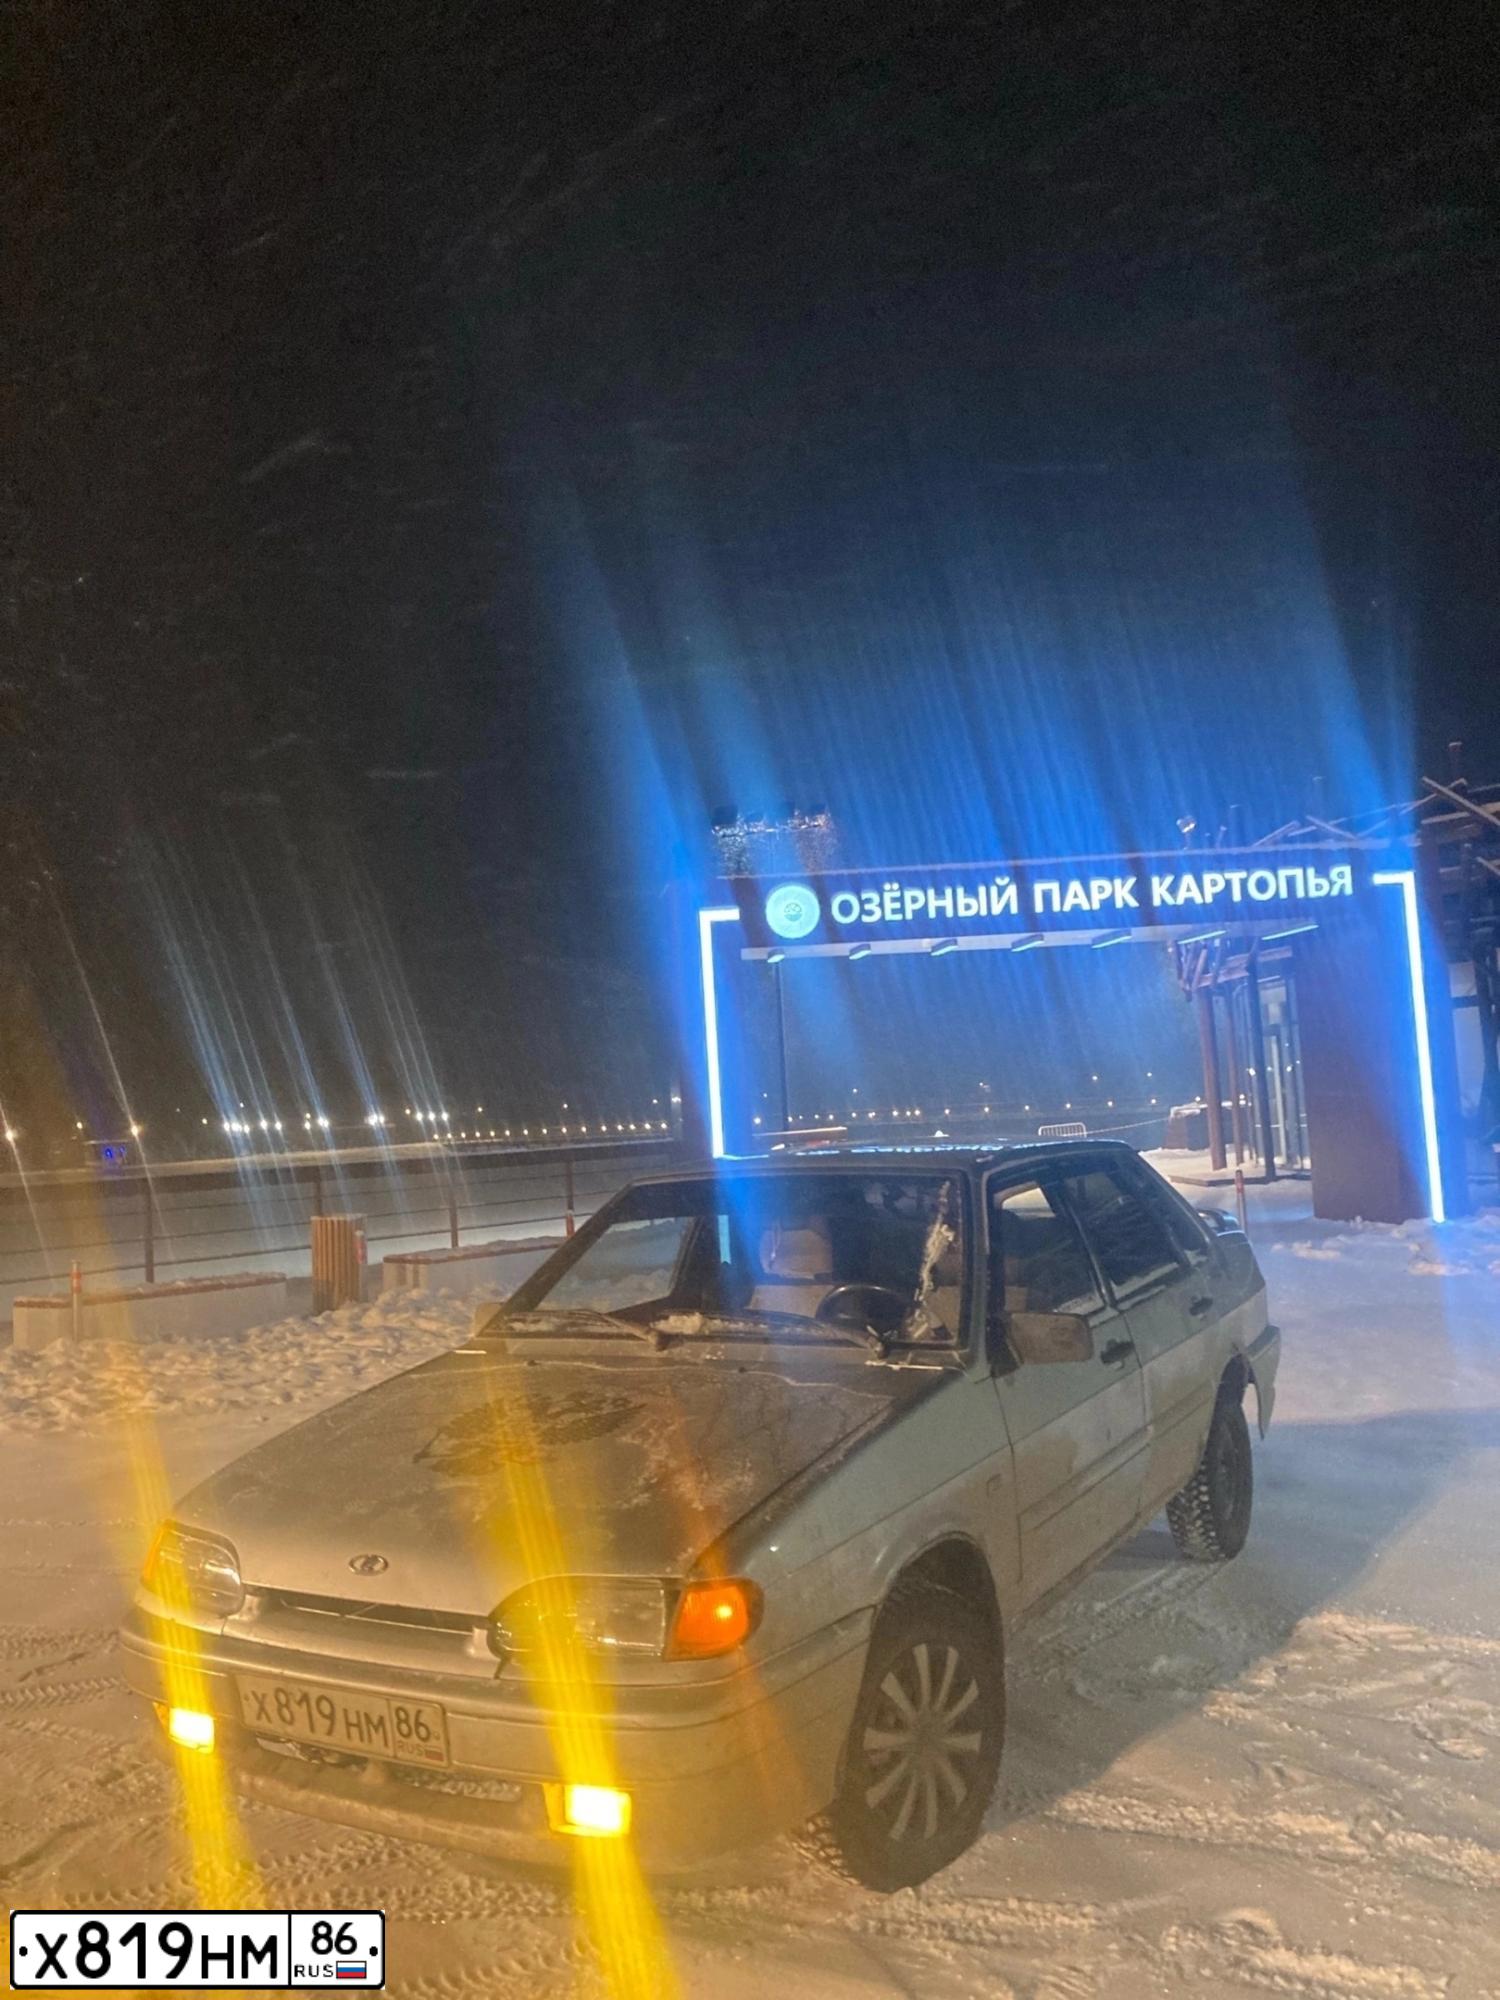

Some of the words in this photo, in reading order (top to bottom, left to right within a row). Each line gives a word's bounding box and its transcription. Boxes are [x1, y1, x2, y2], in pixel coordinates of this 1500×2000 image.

[831, 877, 1018, 924] ОЗЁРНЫЙ
[1033, 876, 1139, 913] ПАРК
[1151, 865, 1353, 908] КАРТОПЬЯ
[395, 1706, 431, 1742] 86
[396, 1740, 425, 1757] RUS
